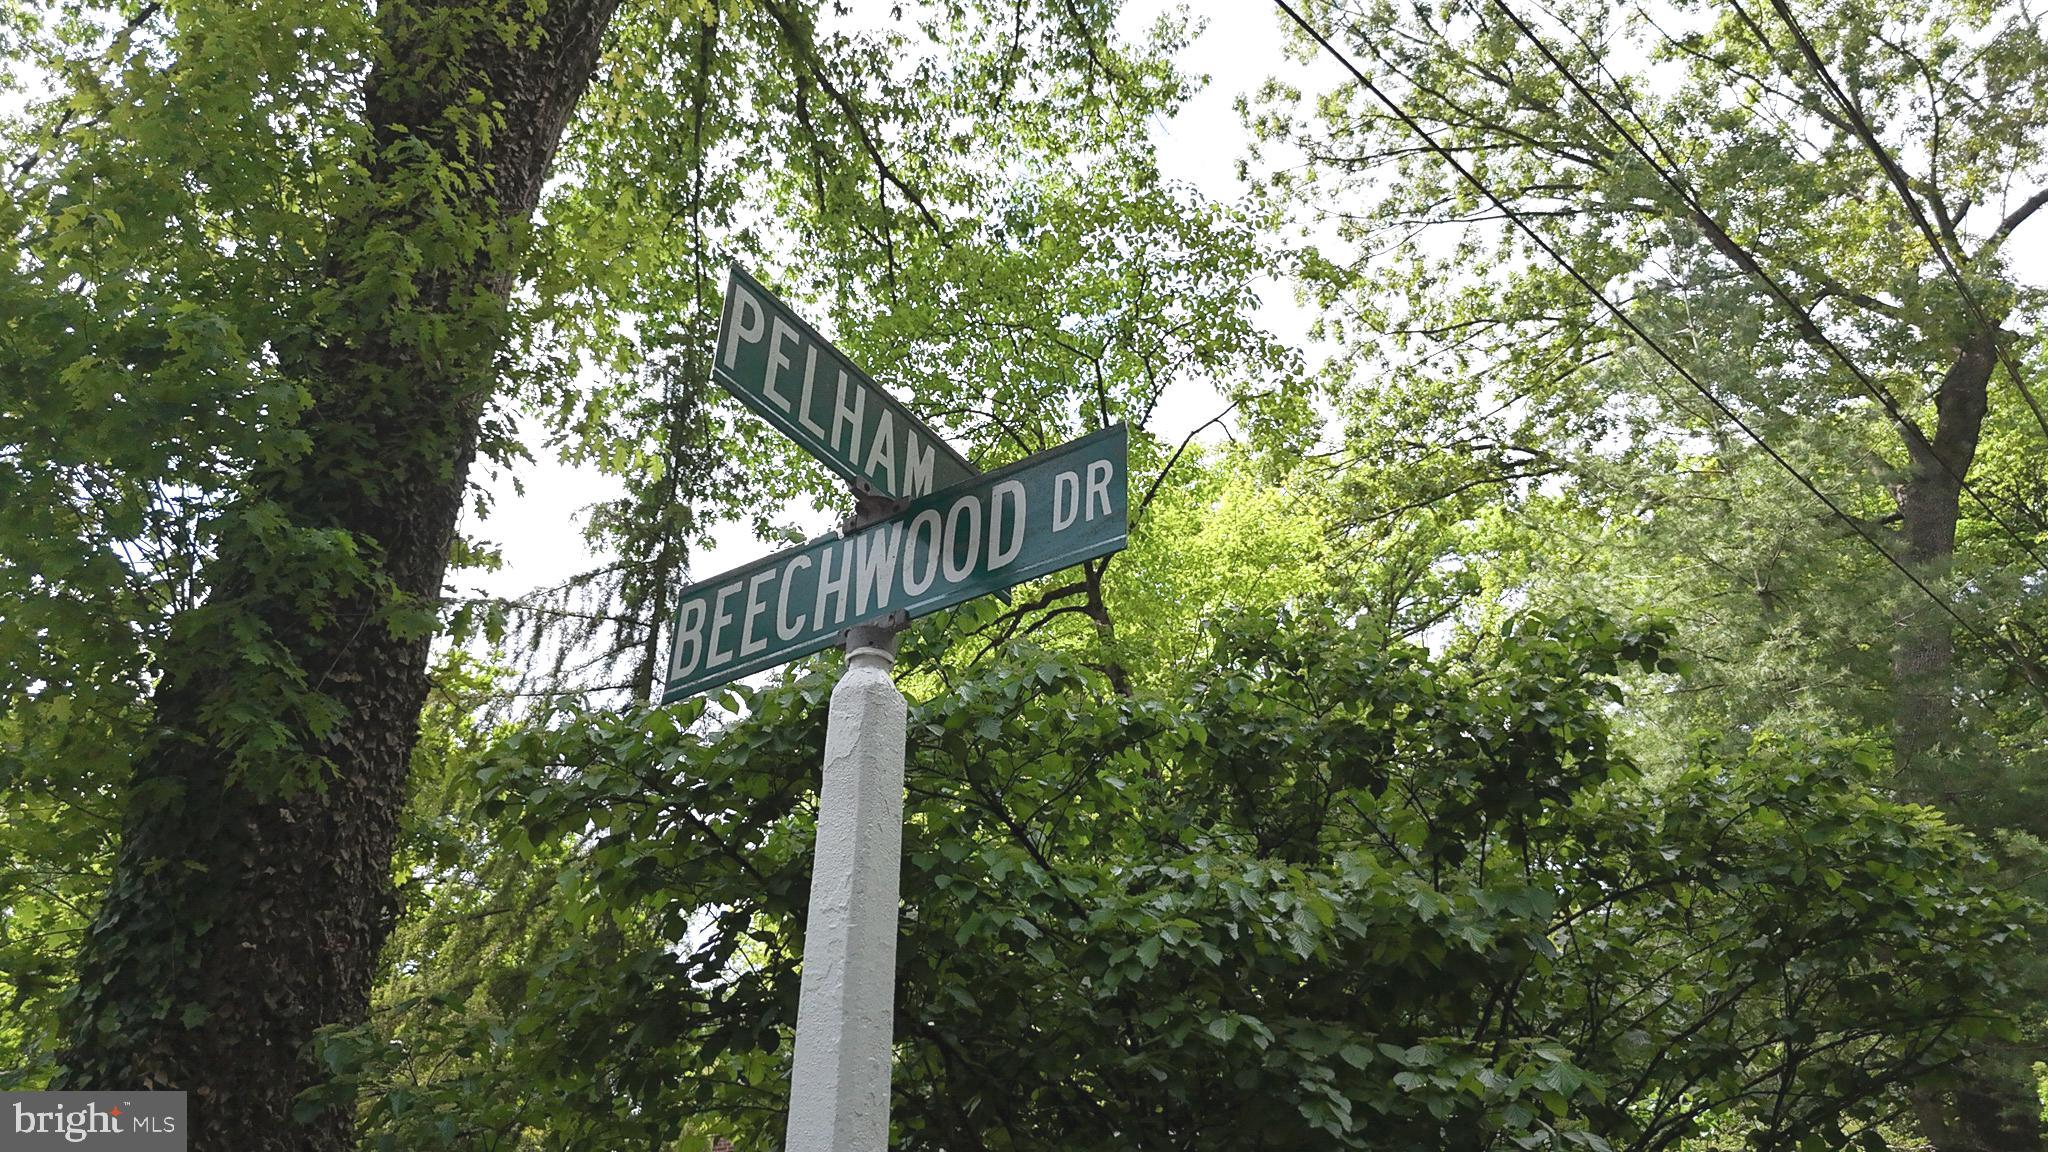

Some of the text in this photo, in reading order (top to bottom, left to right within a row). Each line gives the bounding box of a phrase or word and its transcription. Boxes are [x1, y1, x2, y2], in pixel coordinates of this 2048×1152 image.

[723, 283, 936, 499] PELHAM
[670, 459, 1114, 681] BEECHWOOD DR
